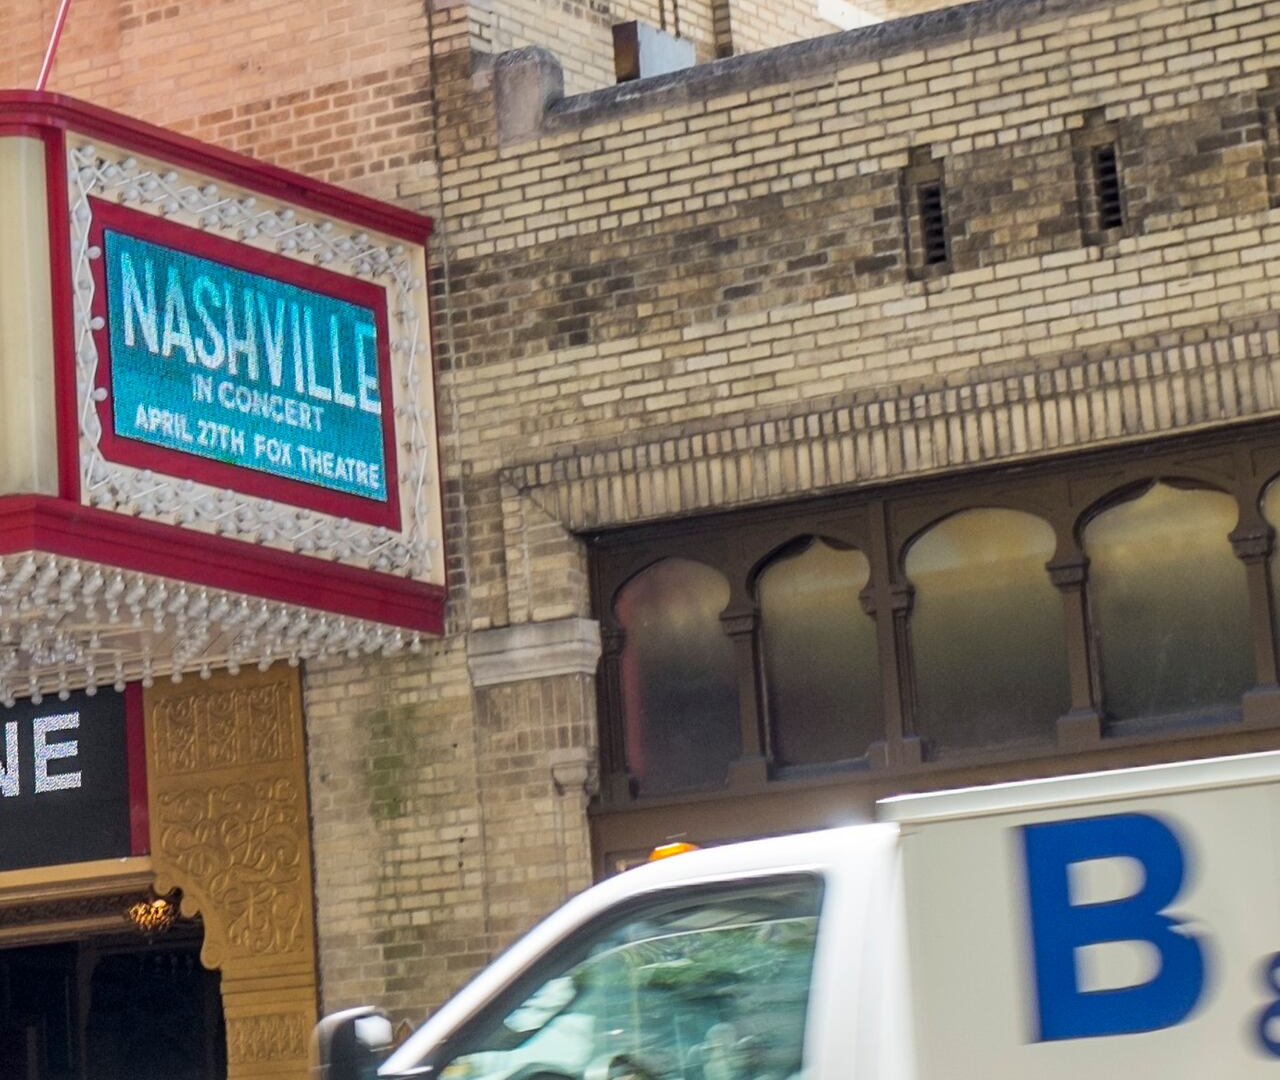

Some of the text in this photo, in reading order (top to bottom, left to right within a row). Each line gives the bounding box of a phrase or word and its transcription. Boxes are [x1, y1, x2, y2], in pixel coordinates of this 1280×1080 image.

[121, 252, 381, 414] NASHVILLE
[135, 404, 380, 489] APRIL 27TH FOX THEATRE
[192, 373, 324, 432] IN CONCERT
[1012, 810, 1210, 1042] B
